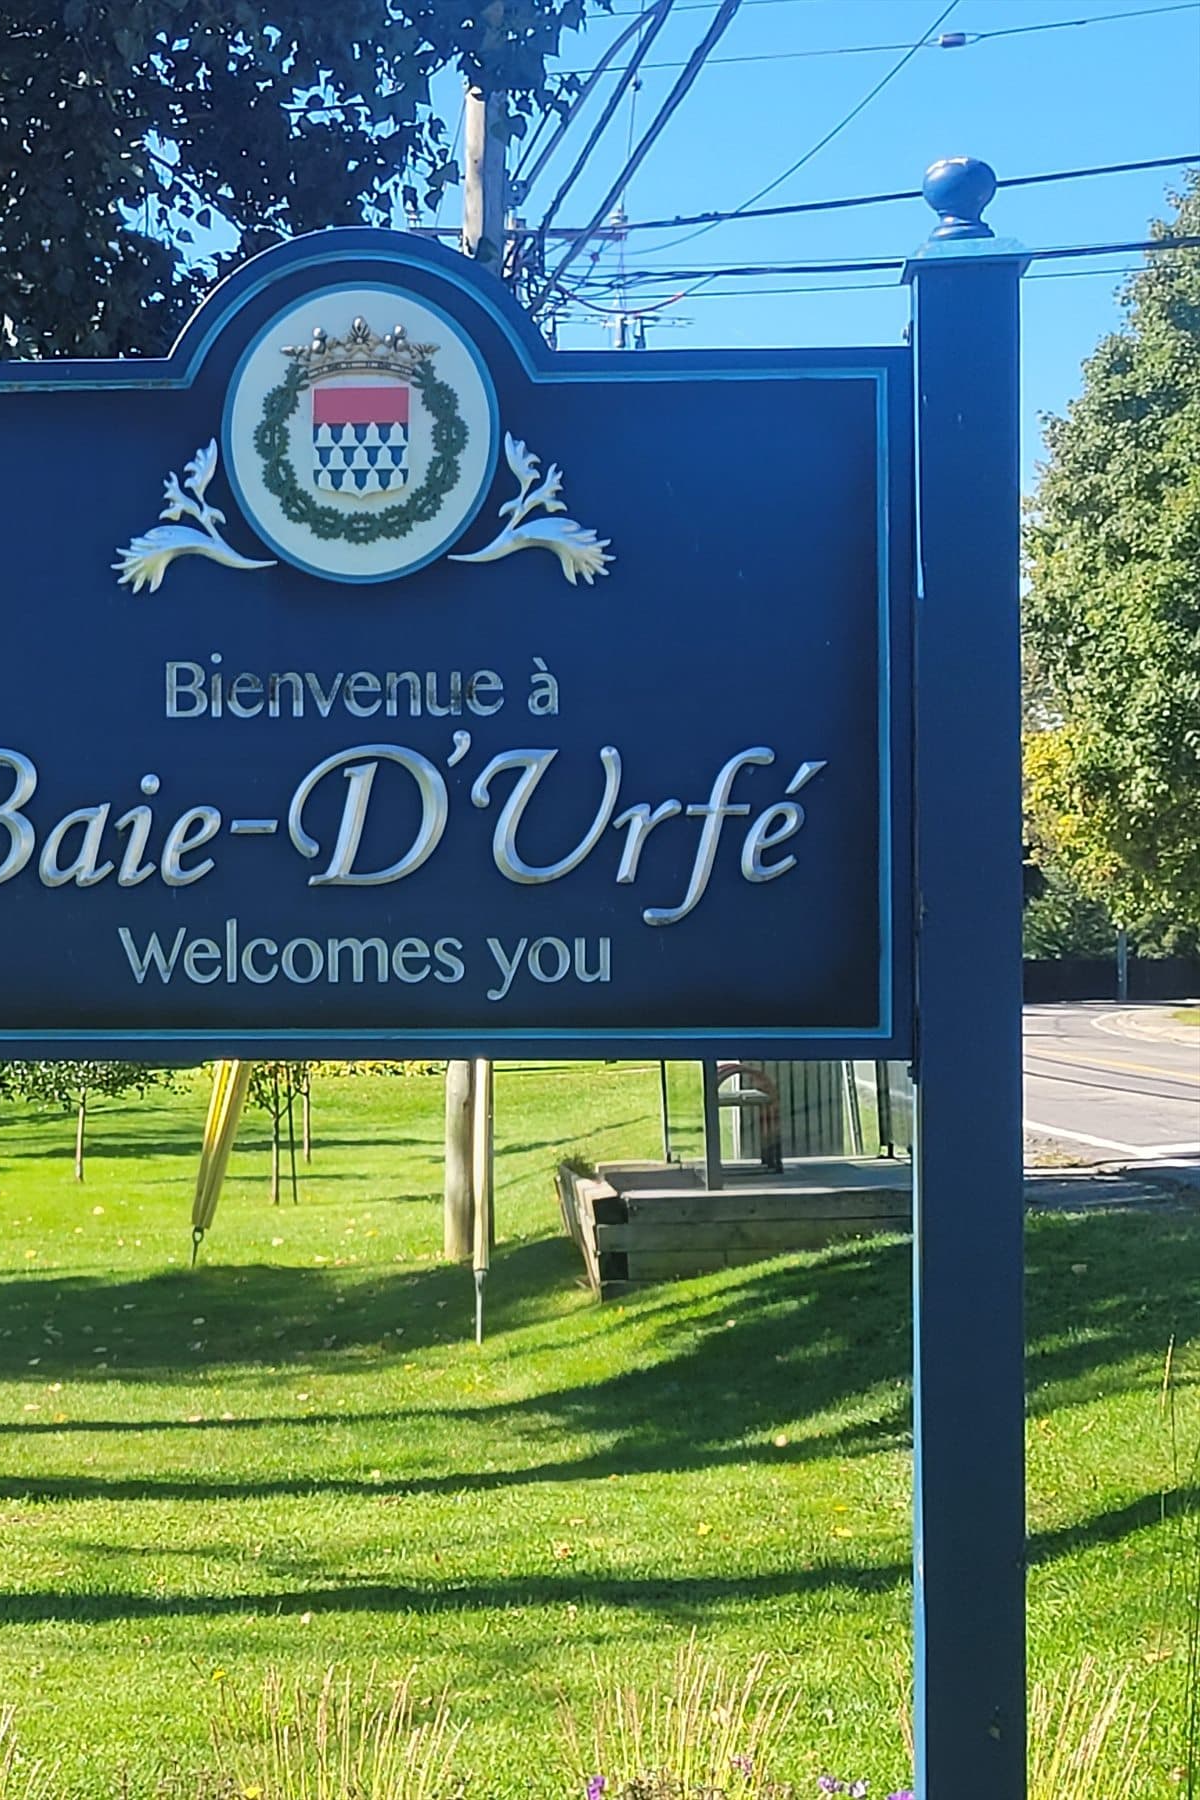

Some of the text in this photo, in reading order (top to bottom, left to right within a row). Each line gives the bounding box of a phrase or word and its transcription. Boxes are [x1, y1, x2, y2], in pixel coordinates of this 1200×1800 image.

[164, 653, 560, 718] Bienvenue à
[117, 918, 612, 1002] Welcomes you
